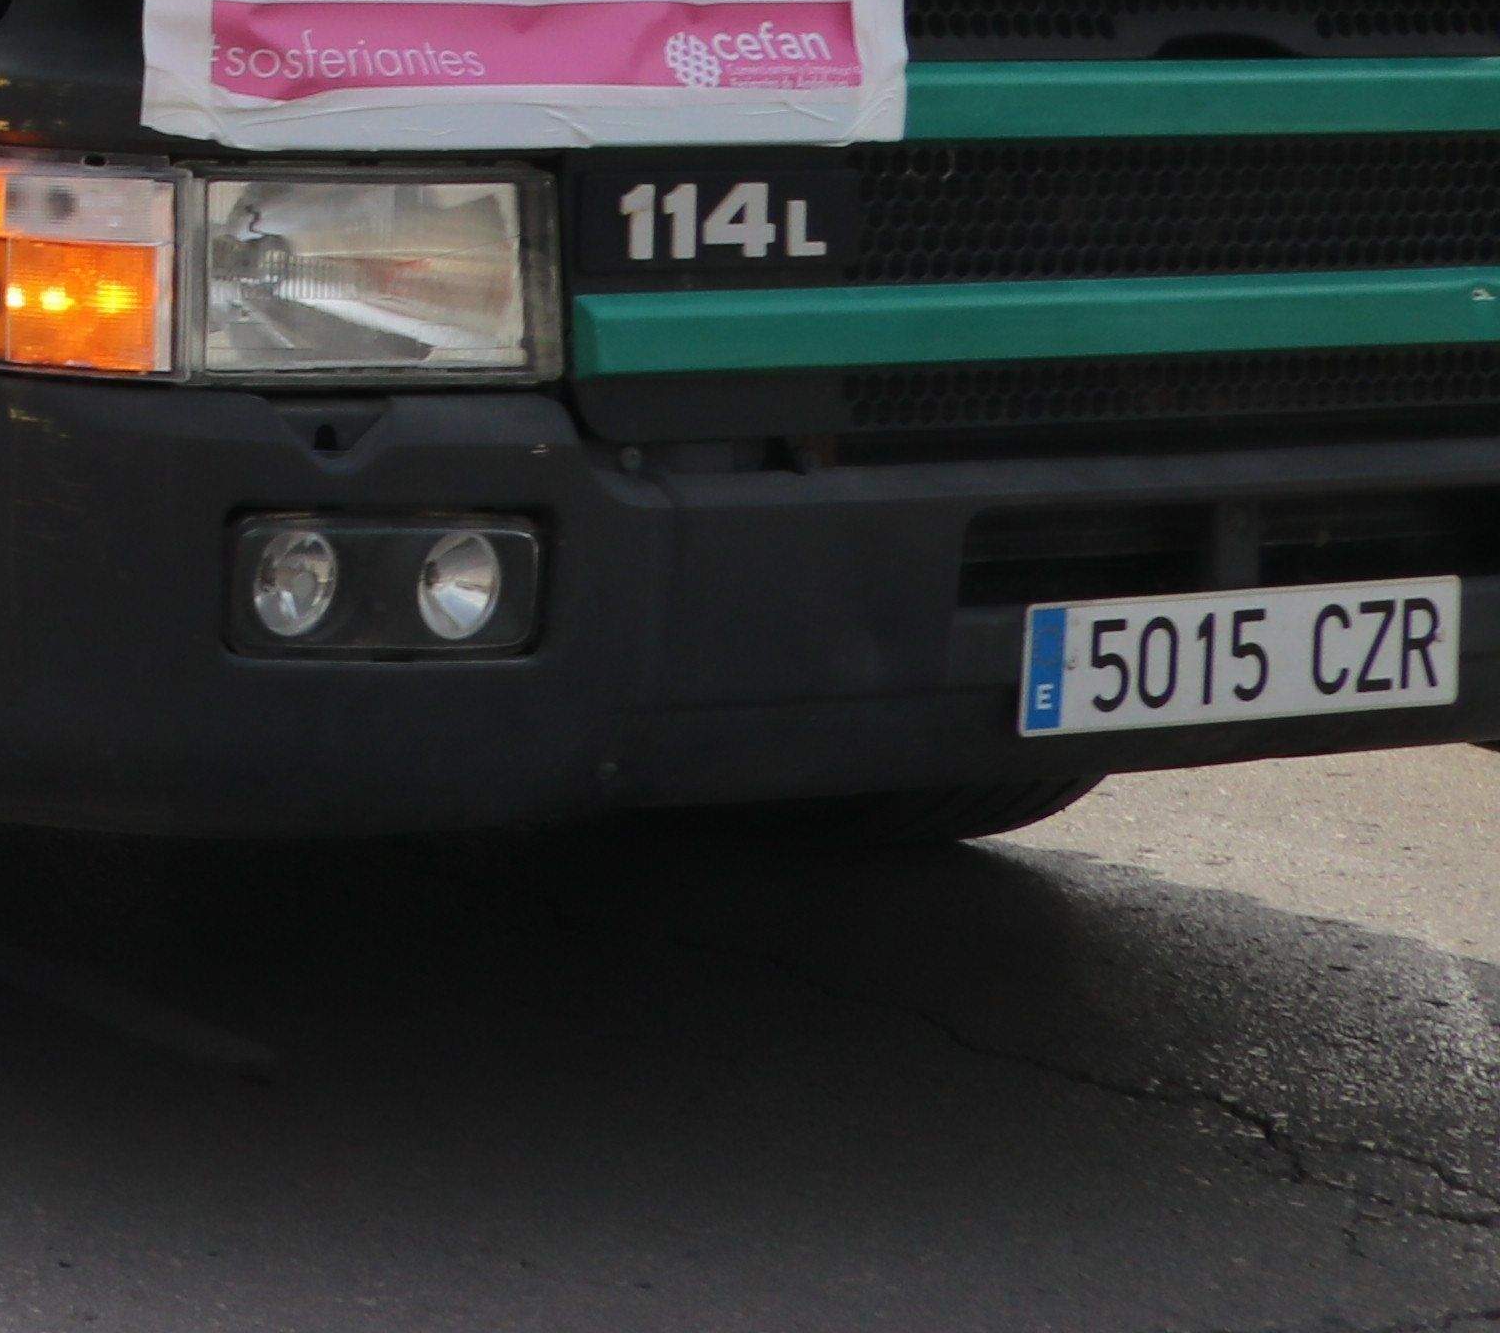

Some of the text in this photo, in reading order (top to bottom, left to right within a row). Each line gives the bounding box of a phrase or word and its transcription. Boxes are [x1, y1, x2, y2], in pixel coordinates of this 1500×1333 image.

[712, 21, 832, 61] cefan
[1036, 596, 1441, 713] E 5015 CZR
